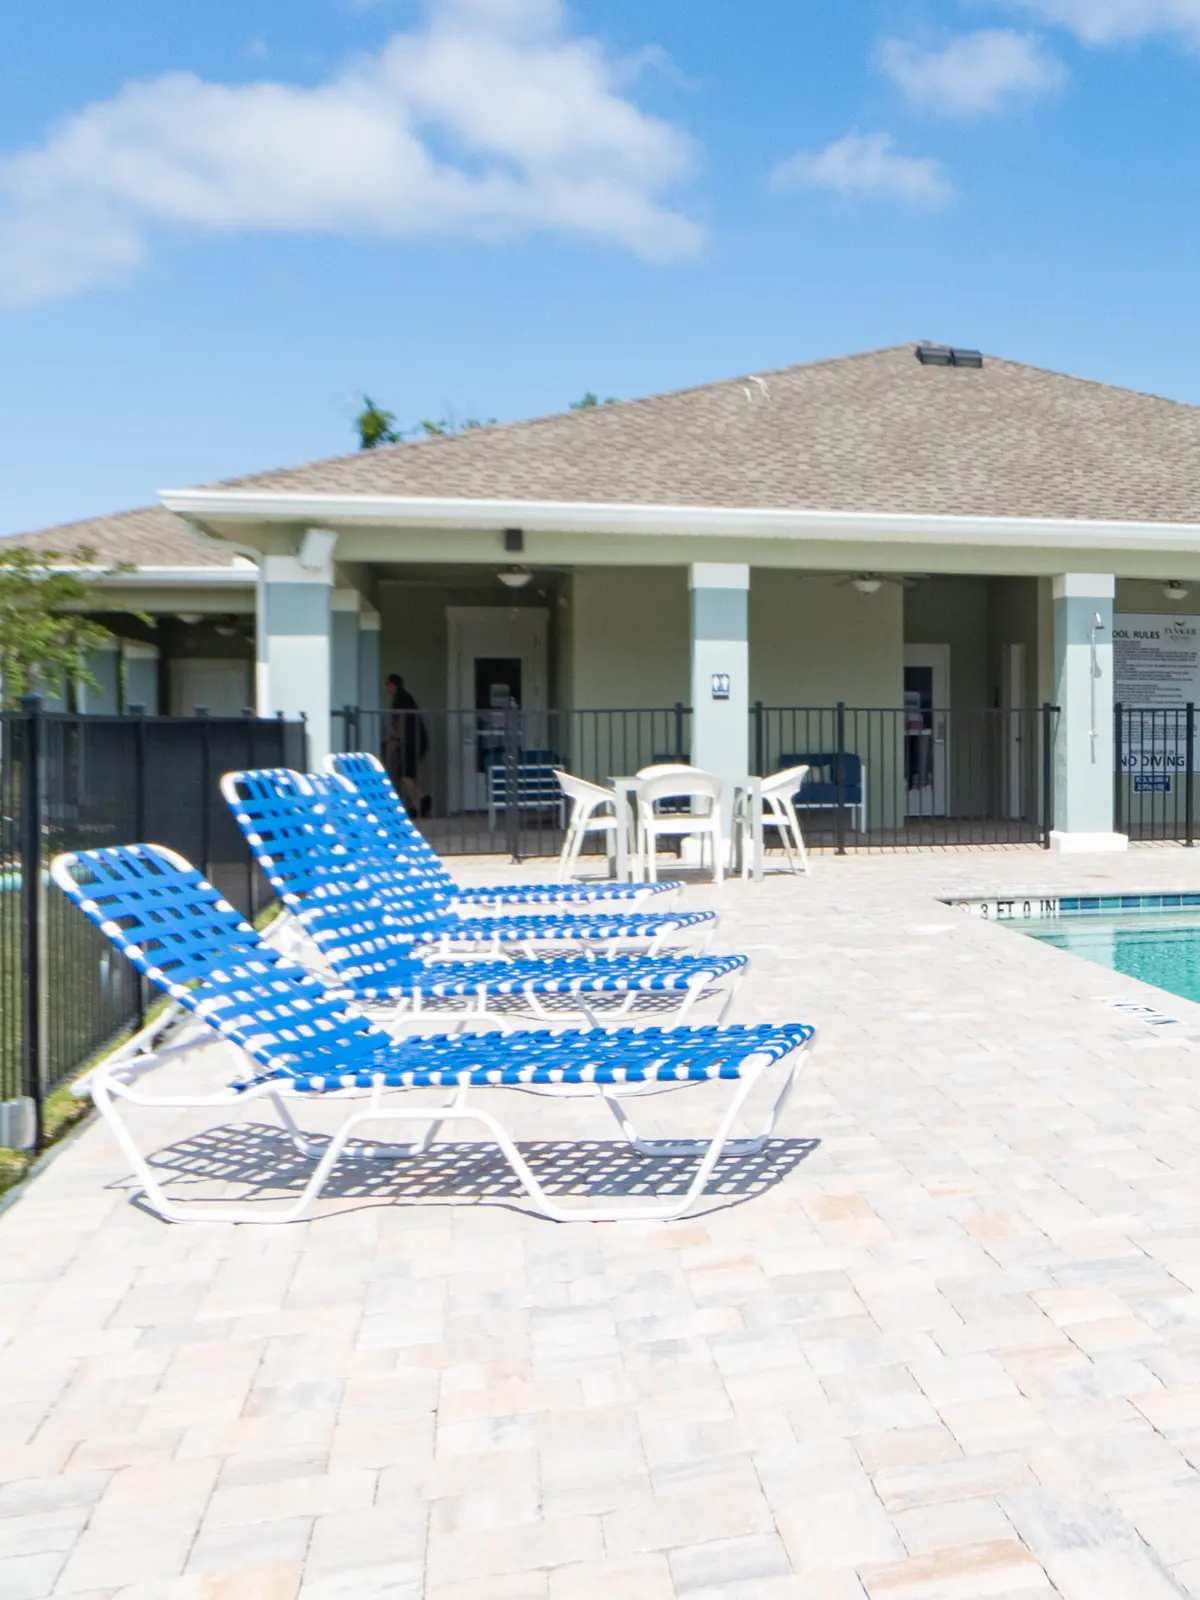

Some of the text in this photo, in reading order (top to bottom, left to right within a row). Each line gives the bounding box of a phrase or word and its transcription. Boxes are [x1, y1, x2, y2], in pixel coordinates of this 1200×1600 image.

[1112, 630, 1129, 638] OOL
[1133, 630, 1160, 639] RULES
[1120, 755, 1185, 767] NO DIVING
[980, 904, 988, 917] 3
